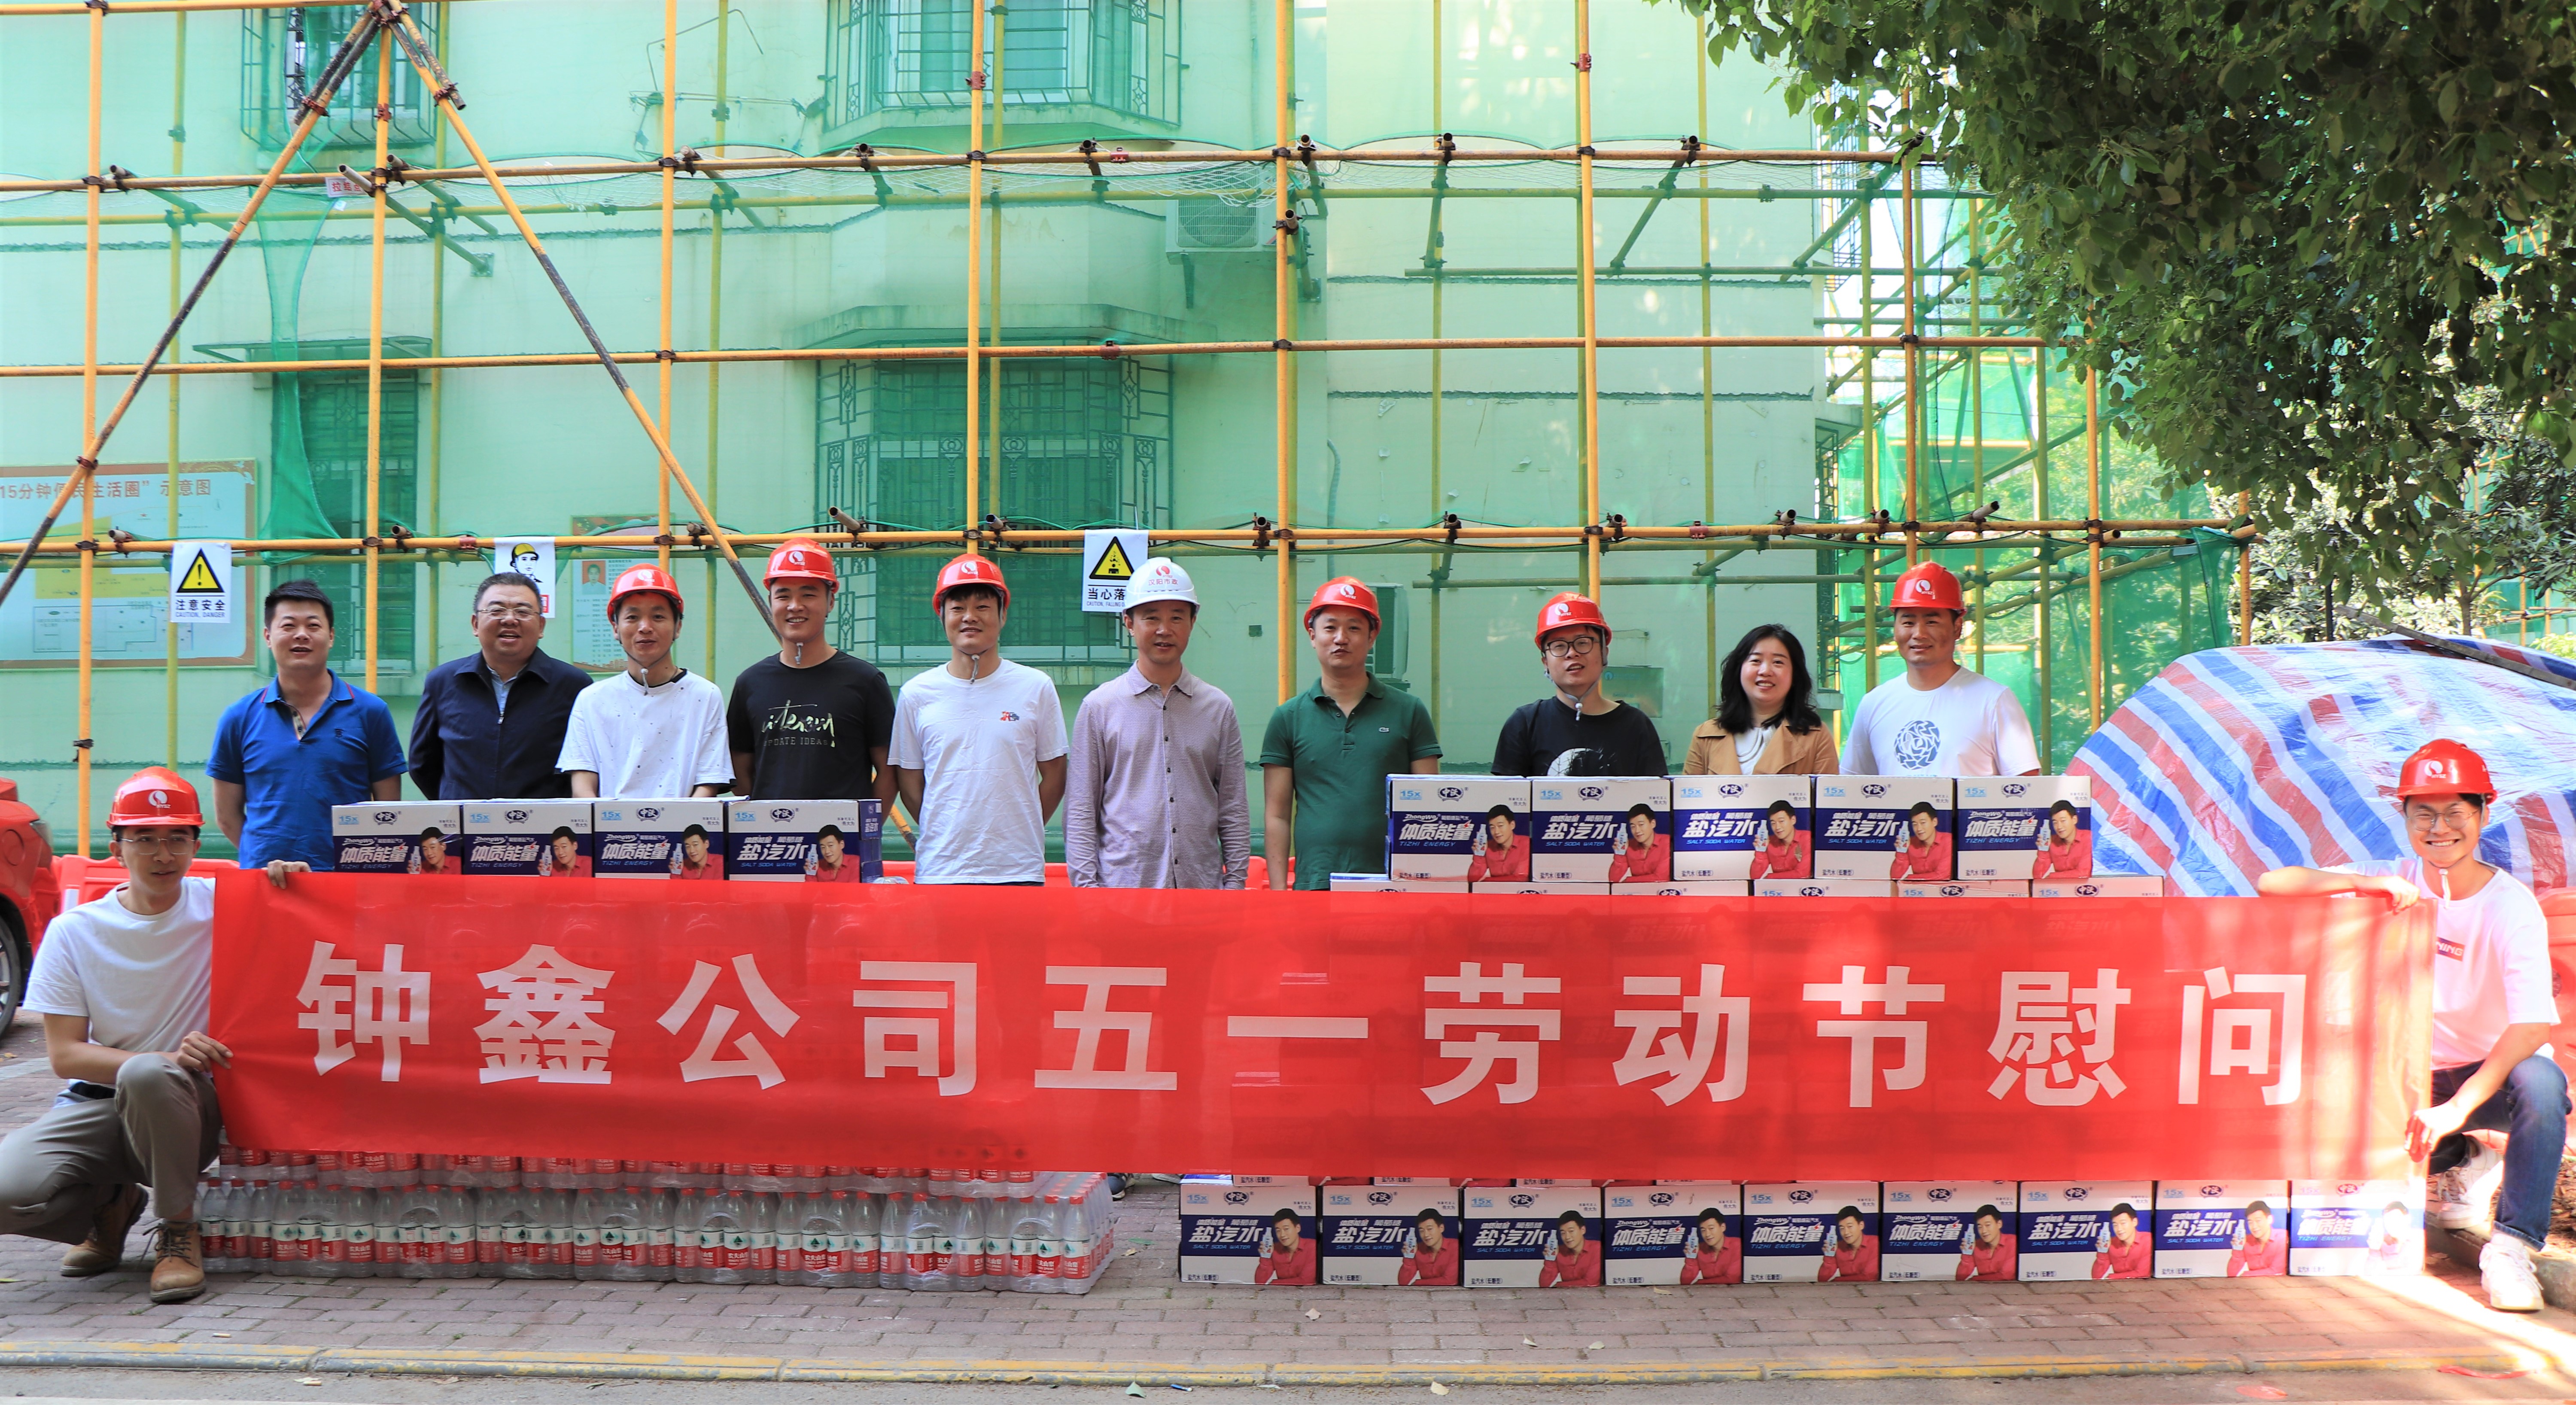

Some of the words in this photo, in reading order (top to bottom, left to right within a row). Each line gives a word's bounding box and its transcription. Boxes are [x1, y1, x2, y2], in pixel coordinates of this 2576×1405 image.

[1088, 588, 1125, 600] 当心落
[176, 599, 225, 610] 注意安全
[1399, 823, 1475, 840] 体质能量
[1542, 823, 1618, 839] 盐汽水
[1682, 820, 1758, 838] 盐汽水
[1824, 820, 1901, 836] 盐汽水
[1965, 820, 2038, 837] 体质能量
[340, 846, 408, 863] 体质能量
[471, 845, 540, 861] 体质能量
[602, 843, 671, 859] 体质能量
[737, 844, 809, 861] 盐汽水
[296, 940, 2308, 1108] 钟鑫公司五一劳动节慰问
[1189, 1226, 1264, 1243] 盐汽水
[1331, 1227, 1407, 1243] 盐汽水
[1612, 1227, 1685, 1246] 体质能量
[1750, 1226, 1825, 1243] 体质能量
[1889, 1223, 1963, 1241] 体质能量
[2028, 1223, 2102, 1240] 盐汽水
[2163, 1219, 2237, 1237] 盐汽水
[1472, 1230, 1548, 1246] 盐汽水
